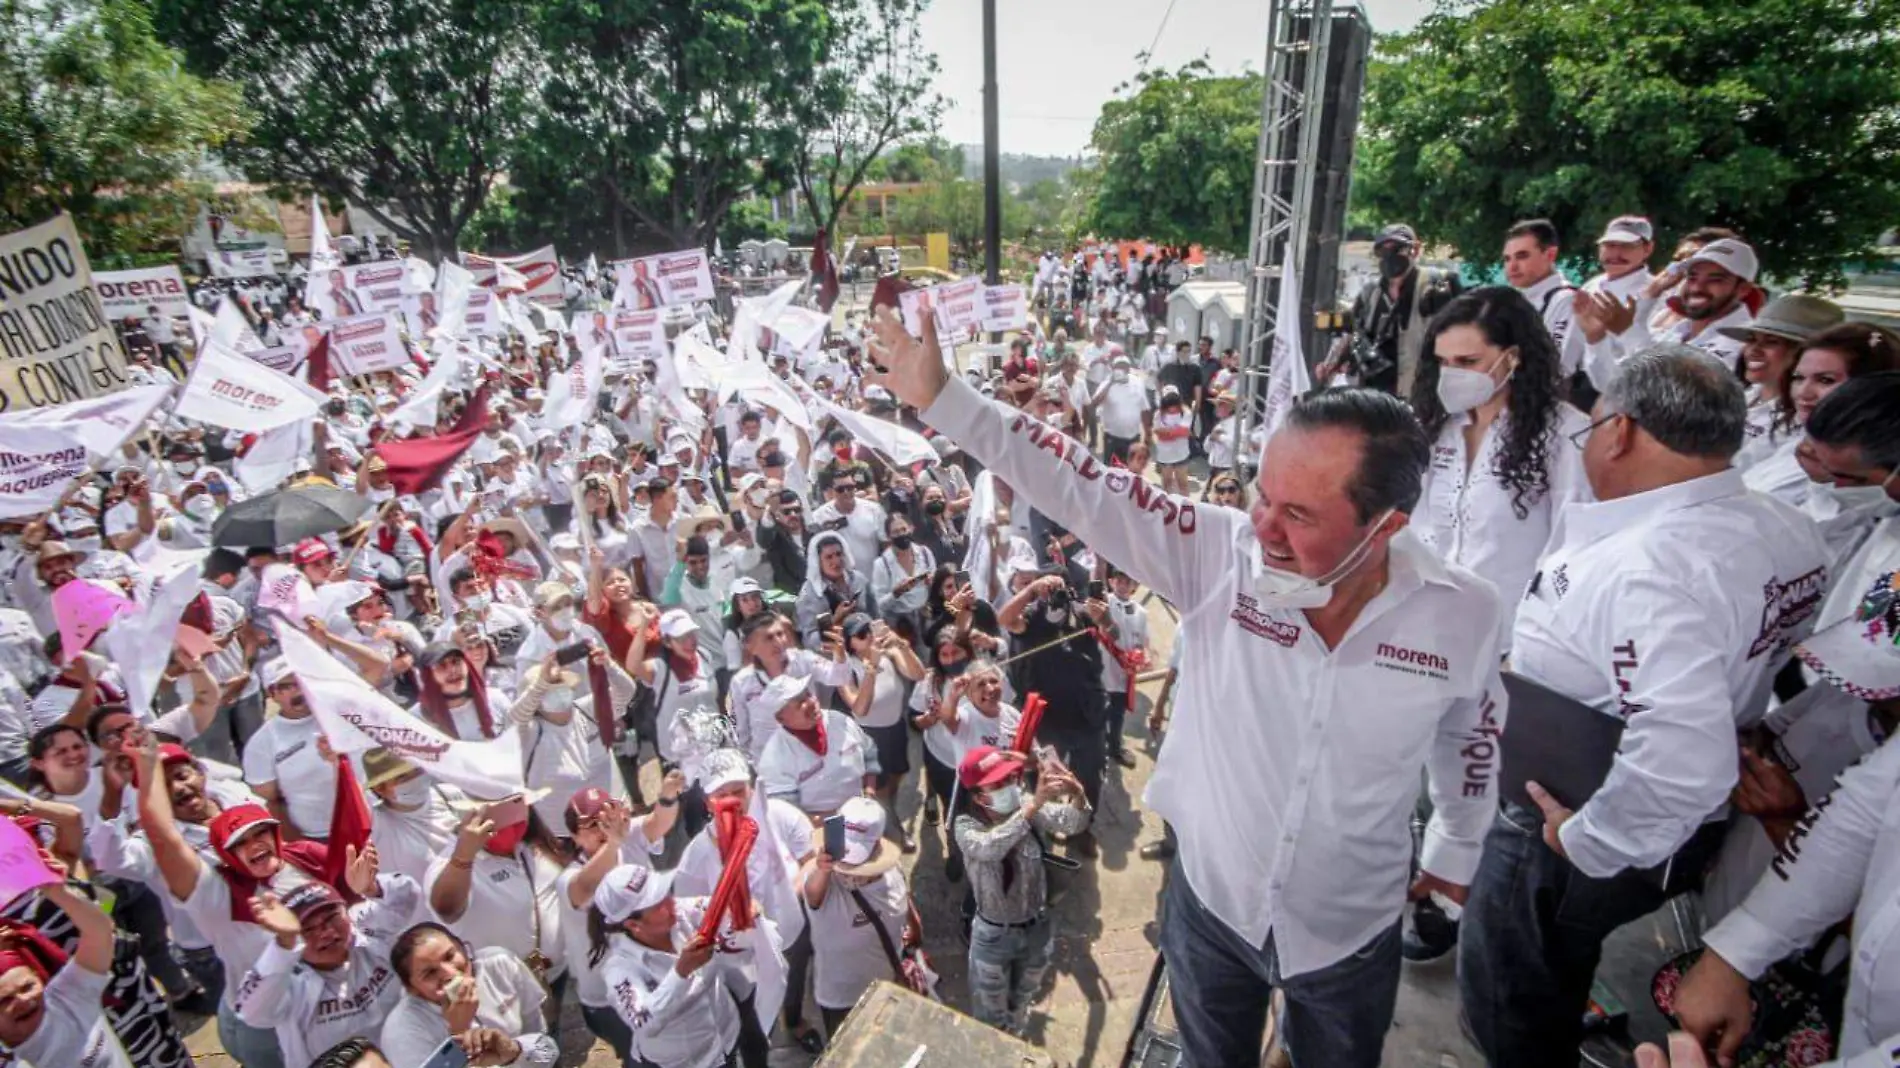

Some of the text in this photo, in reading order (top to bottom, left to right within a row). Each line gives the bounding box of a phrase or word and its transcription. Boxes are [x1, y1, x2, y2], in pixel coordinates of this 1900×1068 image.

[97, 277, 182, 298] orena
[1377, 643, 1449, 671] morena
[318, 966, 389, 1016] morena
